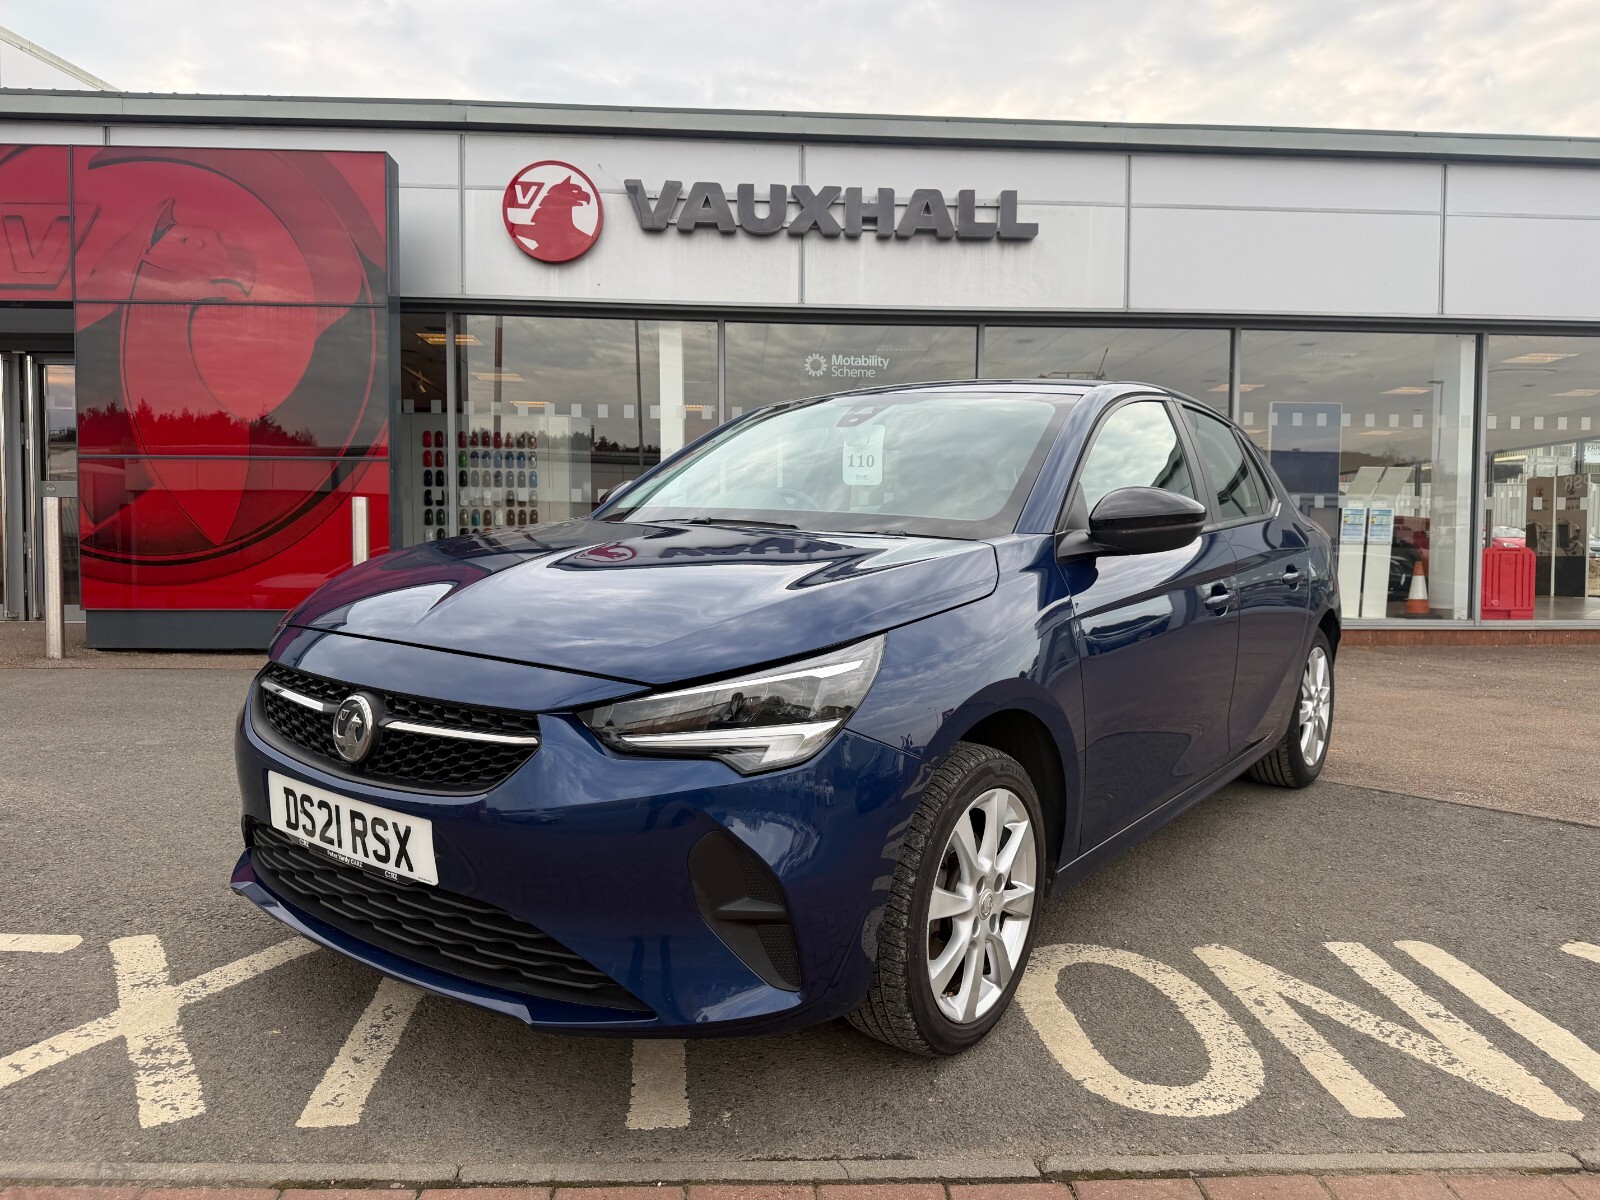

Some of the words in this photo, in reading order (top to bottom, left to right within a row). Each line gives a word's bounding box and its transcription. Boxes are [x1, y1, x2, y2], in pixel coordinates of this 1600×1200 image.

[624, 178, 1039, 242] VAUXHALL
[831, 354, 890, 370] Motability
[831, 366, 876, 378] Scheme
[847, 454, 875, 468] 110
[282, 786, 343, 849] DS21
[349, 808, 414, 873] RSX
[1016, 939, 1600, 1122] ONL
